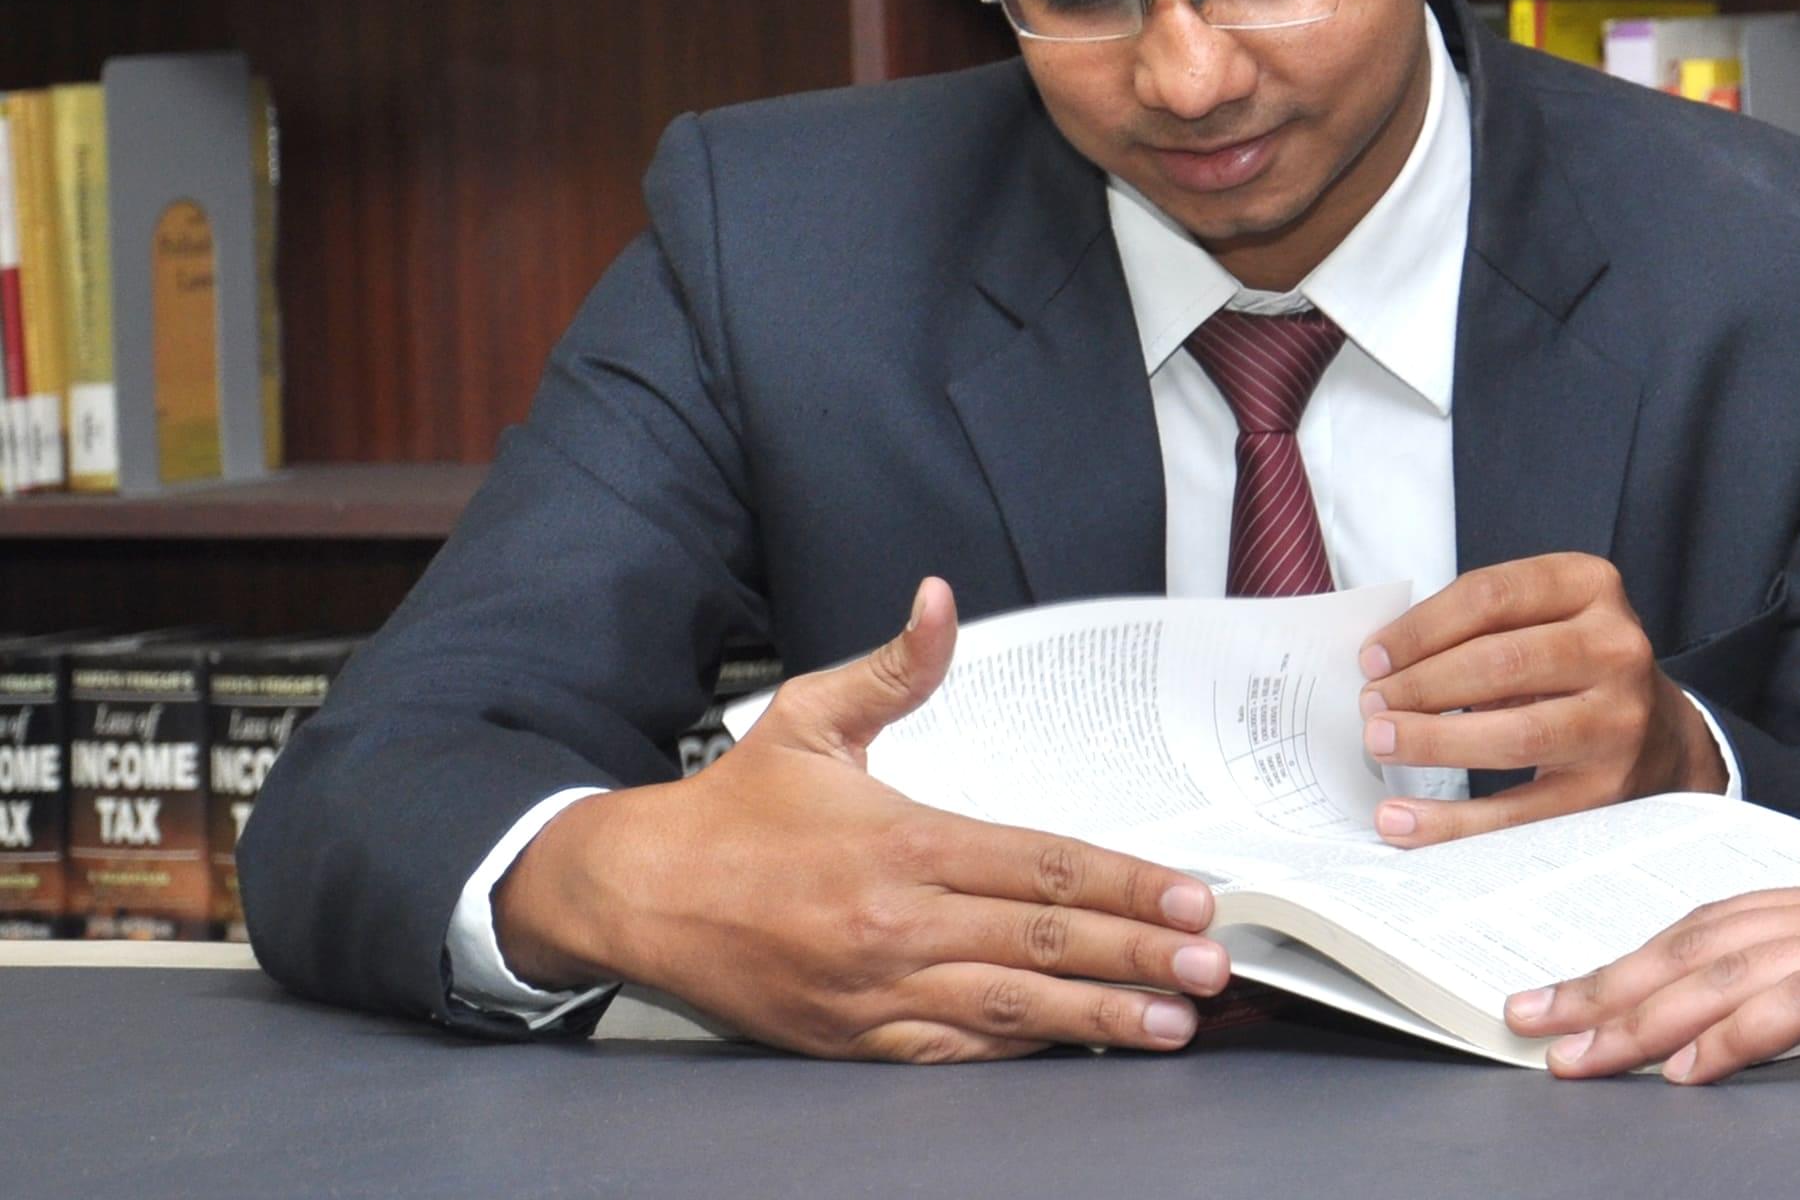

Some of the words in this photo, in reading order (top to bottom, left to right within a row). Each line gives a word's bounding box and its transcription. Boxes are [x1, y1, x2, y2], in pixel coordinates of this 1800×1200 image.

[94, 703, 138, 736] Law
[137, 702, 164, 744] of
[228, 707, 266, 741] Law
[71, 741, 200, 791] INCOME
[210, 745, 279, 795] INCO
[94, 796, 162, 845] TAX
